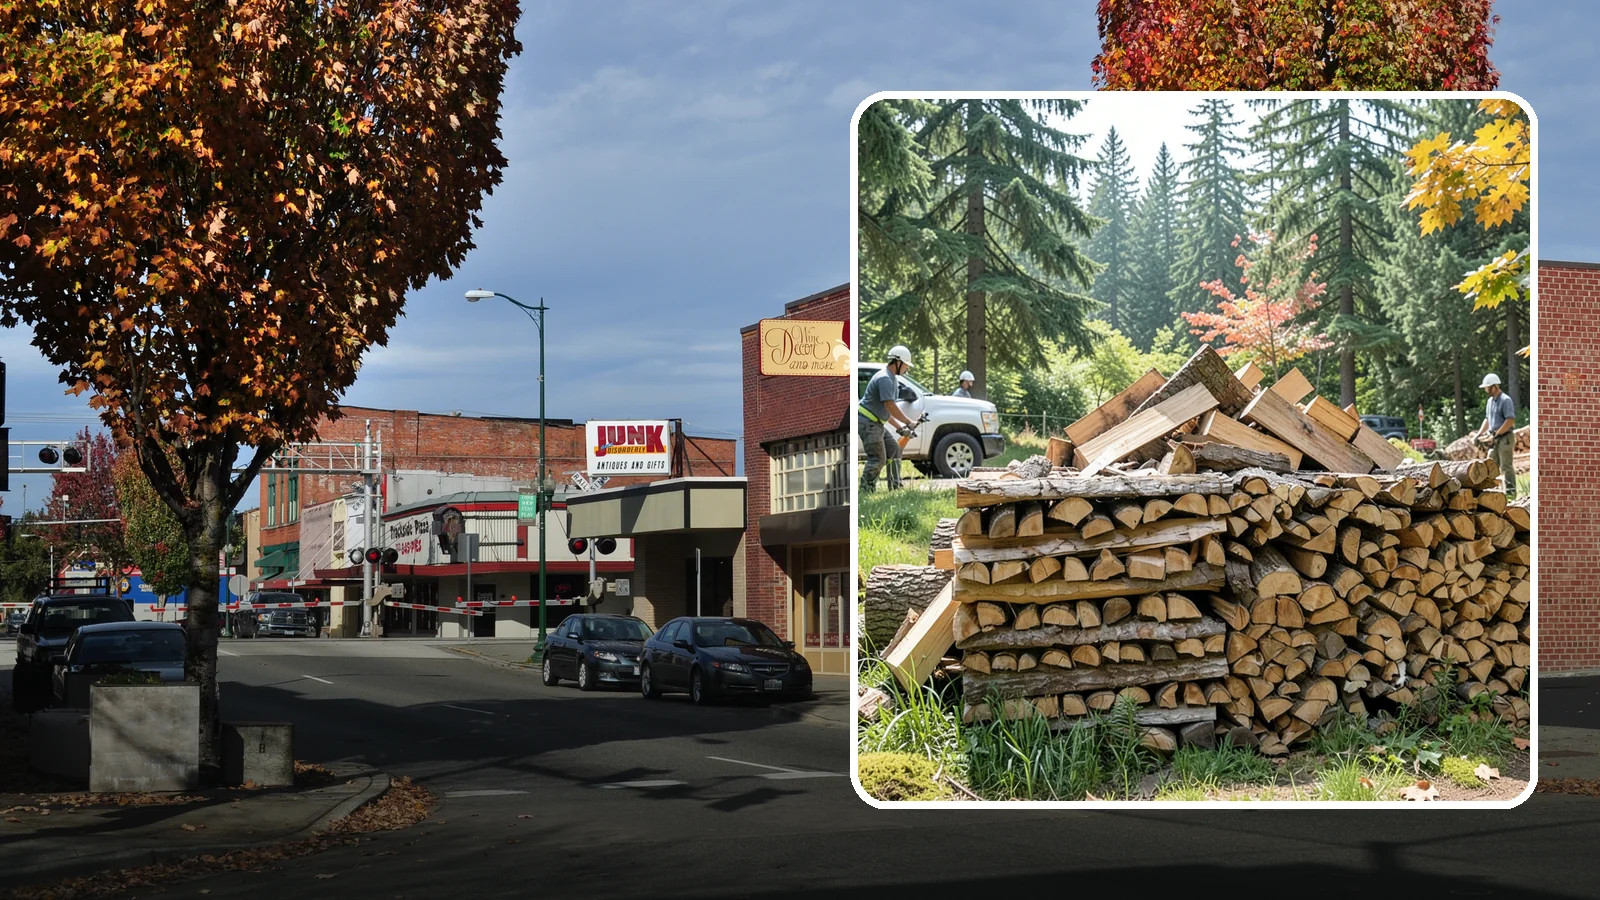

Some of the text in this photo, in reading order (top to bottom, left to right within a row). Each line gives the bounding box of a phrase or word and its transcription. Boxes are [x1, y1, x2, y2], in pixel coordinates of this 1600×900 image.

[595, 425, 665, 457] JUNK
[607, 445, 646, 454] DISORDERLY
[597, 460, 665, 470] ANTIQUES AND GIFTS
[414, 519, 429, 534] Pizza
